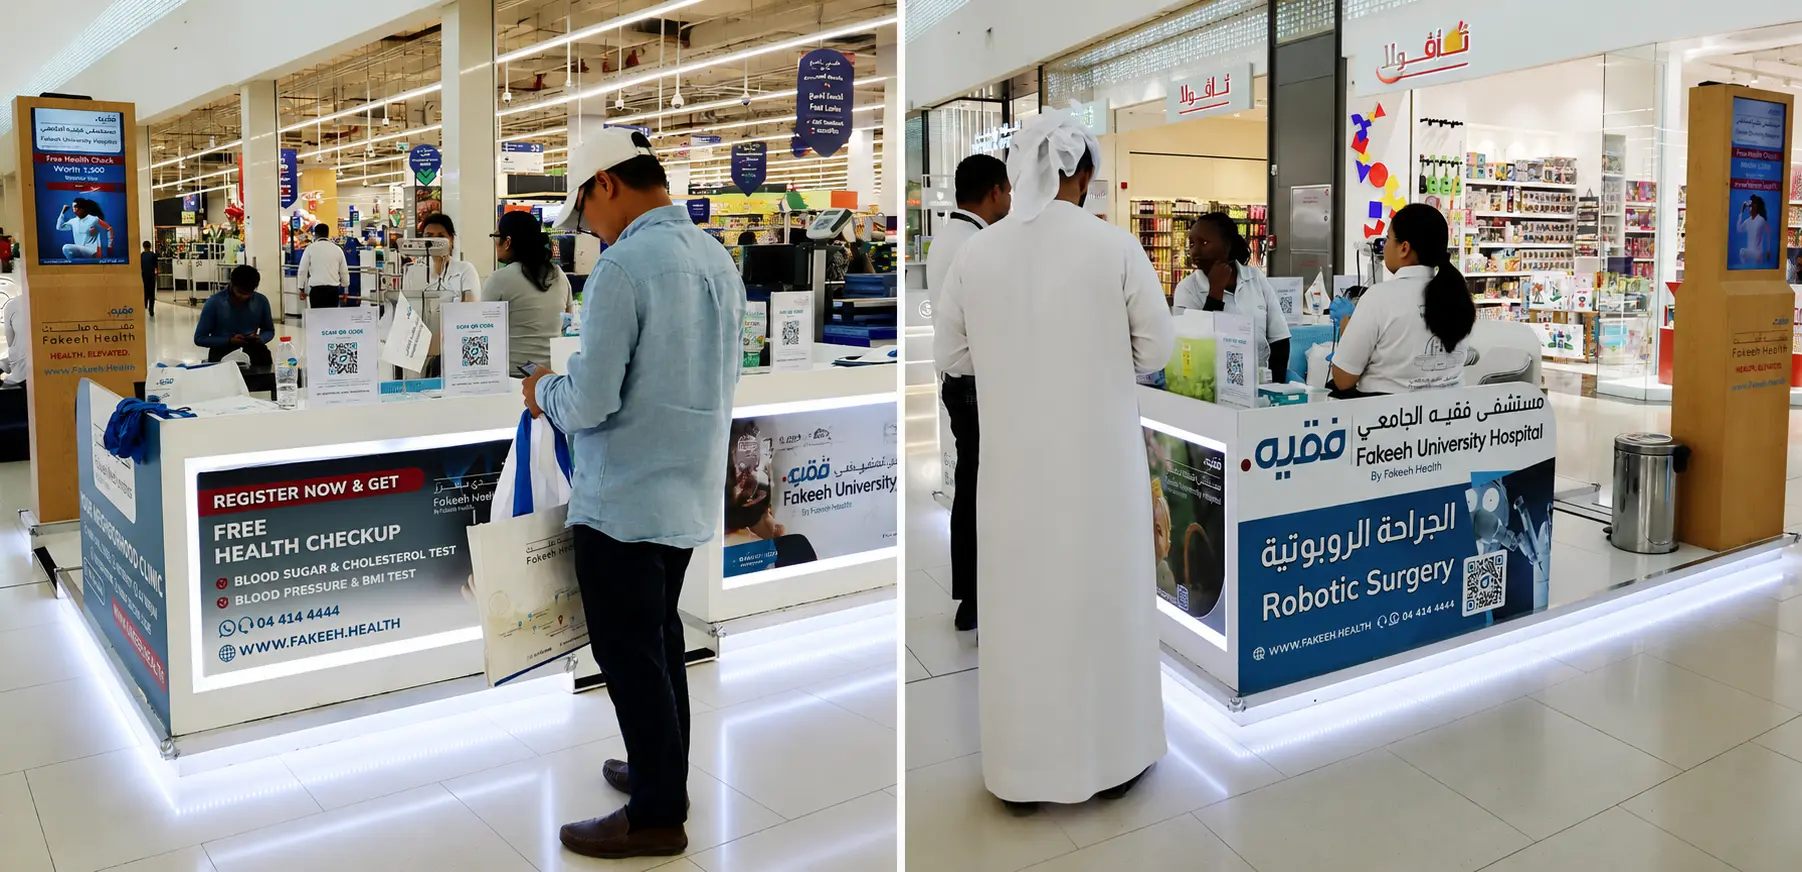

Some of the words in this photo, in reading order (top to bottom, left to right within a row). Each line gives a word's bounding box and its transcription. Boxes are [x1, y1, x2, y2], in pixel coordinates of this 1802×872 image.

[42, 334, 89, 345] Fakeeh
[94, 332, 135, 343] Health
[1358, 405, 1423, 441] الجامعي
[1476, 394, 1545, 422] مستشفى
[1255, 417, 1347, 481] فقيه
[1356, 442, 1412, 467] Fakeeh
[1417, 433, 1487, 458] University
[1490, 423, 1544, 447] Hospital
[783, 484, 832, 506] Fakeeh
[835, 474, 897, 498] University
[1370, 471, 1382, 483] By
[1384, 468, 1414, 479] Fakeeh
[1415, 461, 1442, 473] Health
[213, 486, 299, 509] REGISTER
[304, 480, 347, 499] NOW
[352, 479, 364, 492] &
[368, 475, 399, 490] GET
[213, 519, 267, 541] FREE
[1377, 502, 1456, 545] الجراحة
[215, 538, 300, 564] HEALTH
[306, 524, 401, 552] CHECKUP
[1261, 519, 1370, 574] الروبوتية
[234, 570, 280, 588] BLOOD
[283, 564, 327, 580] SUGAR
[330, 562, 340, 572] &
[342, 550, 426, 570] CHOLESTEROL
[429, 545, 457, 558] TEST
[235, 590, 280, 606] BLOOD
[283, 579, 347, 598] PRESSURE
[350, 577, 360, 587] &
[362, 573, 385, 586] BMI
[387, 568, 416, 582] TEST
[1263, 576, 1359, 622] Robotic
[1366, 558, 1455, 596] Surgery
[257, 615, 274, 629] 04
[278, 611, 303, 625] 414
[306, 605, 340, 620] 4444
[1402, 611, 1413, 621] 04
[1415, 605, 1432, 618] 414
[1434, 599, 1455, 612] 4444
[239, 618, 401, 656] WWW.FAKEEH.HEALTH
